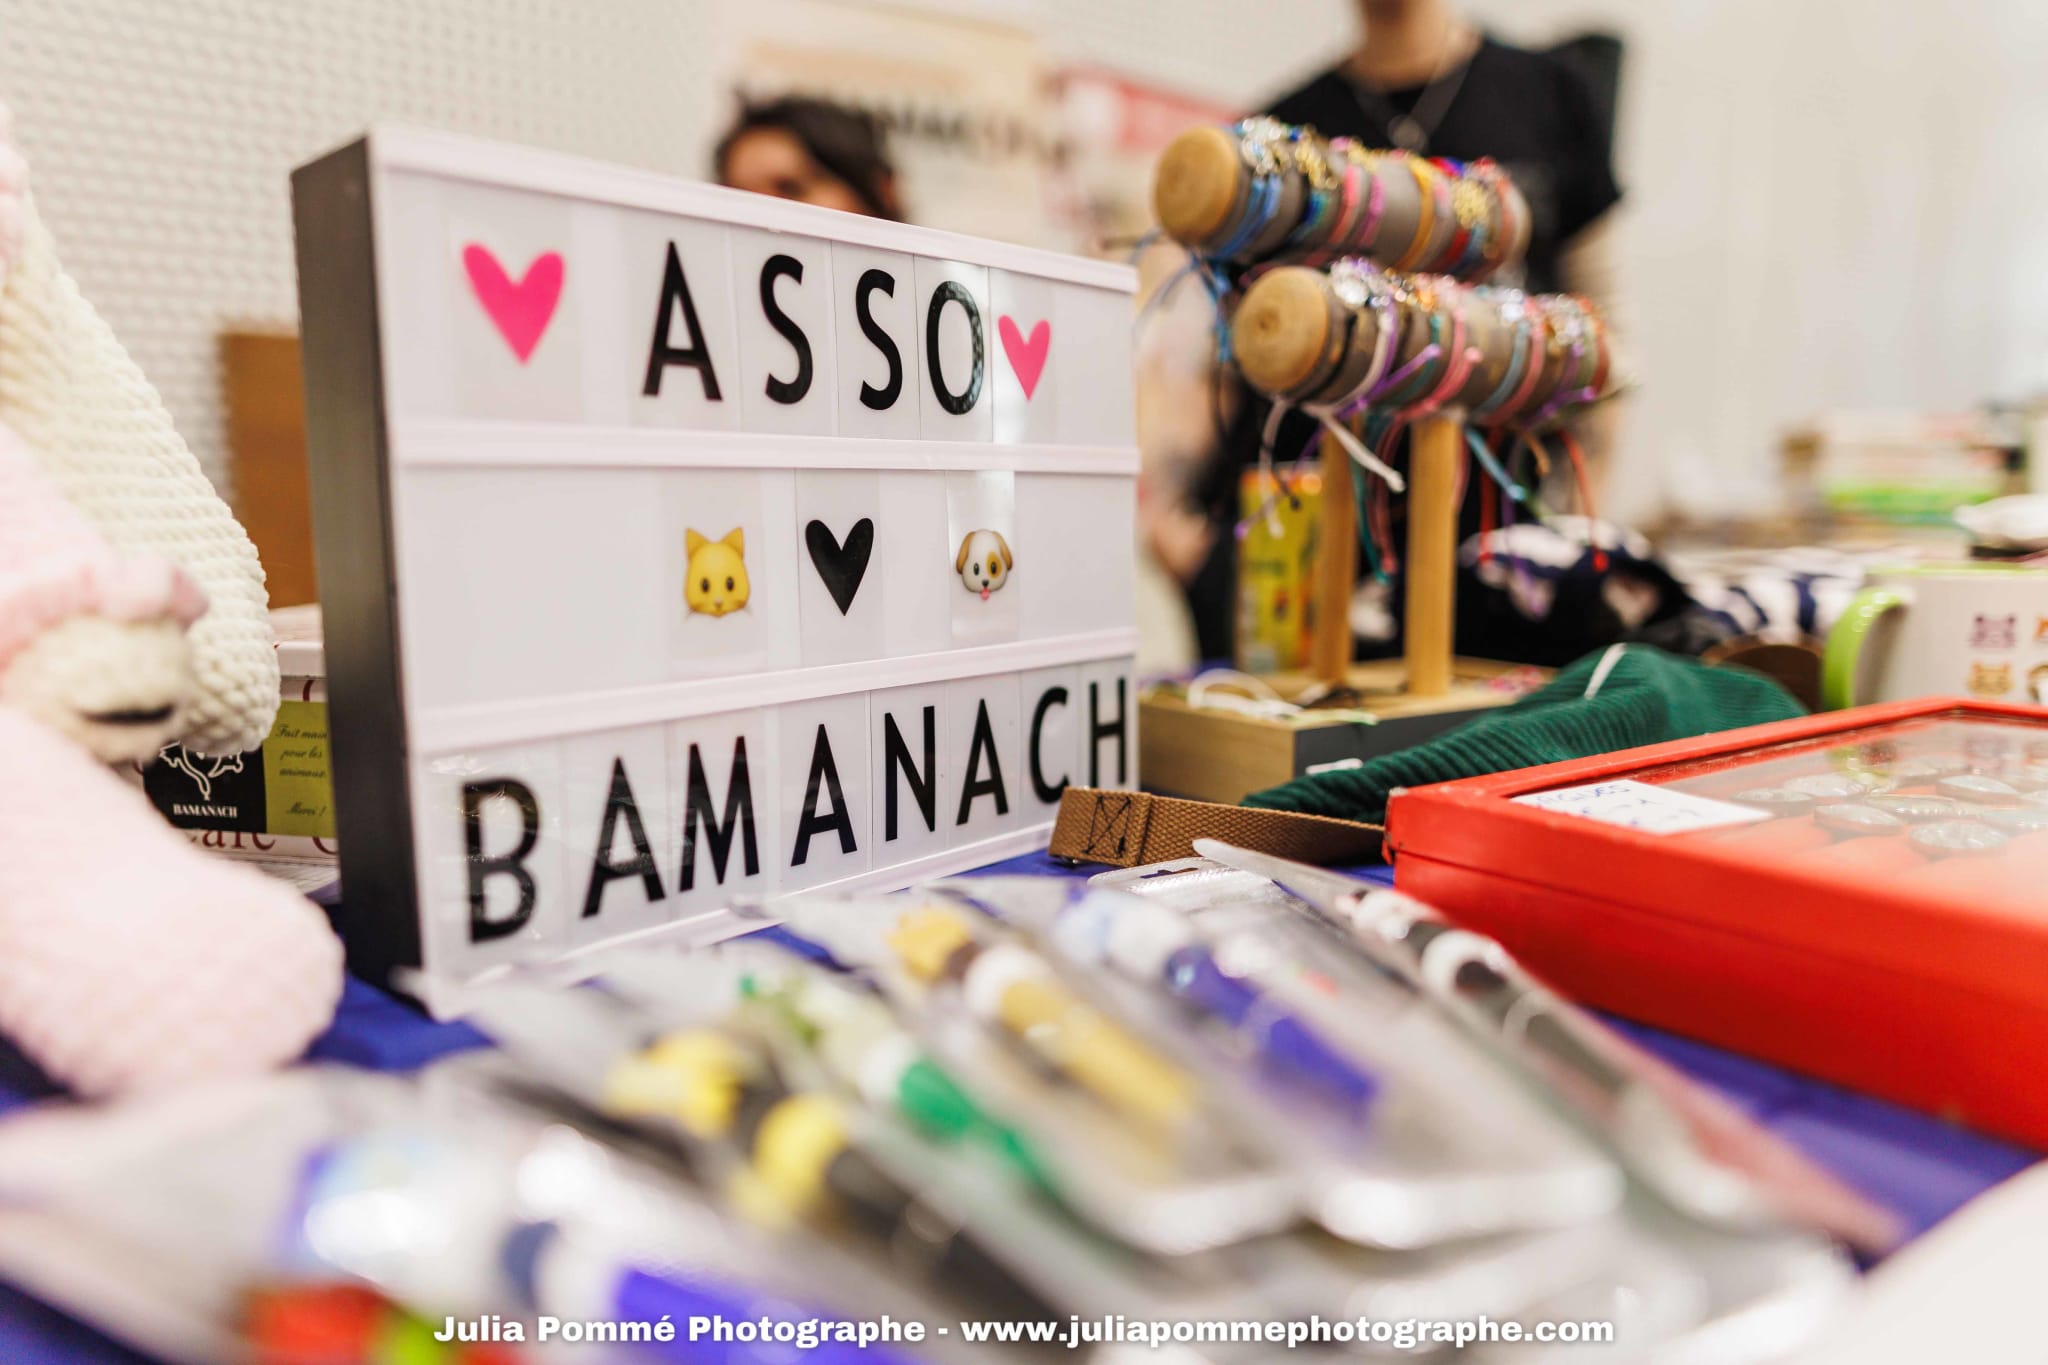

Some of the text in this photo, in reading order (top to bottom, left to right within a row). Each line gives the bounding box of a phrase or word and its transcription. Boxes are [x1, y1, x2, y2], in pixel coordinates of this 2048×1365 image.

[642, 240, 984, 415] ASSO
[173, 803, 237, 818] BAMANACH
[459, 677, 1128, 944] BAMANACH
